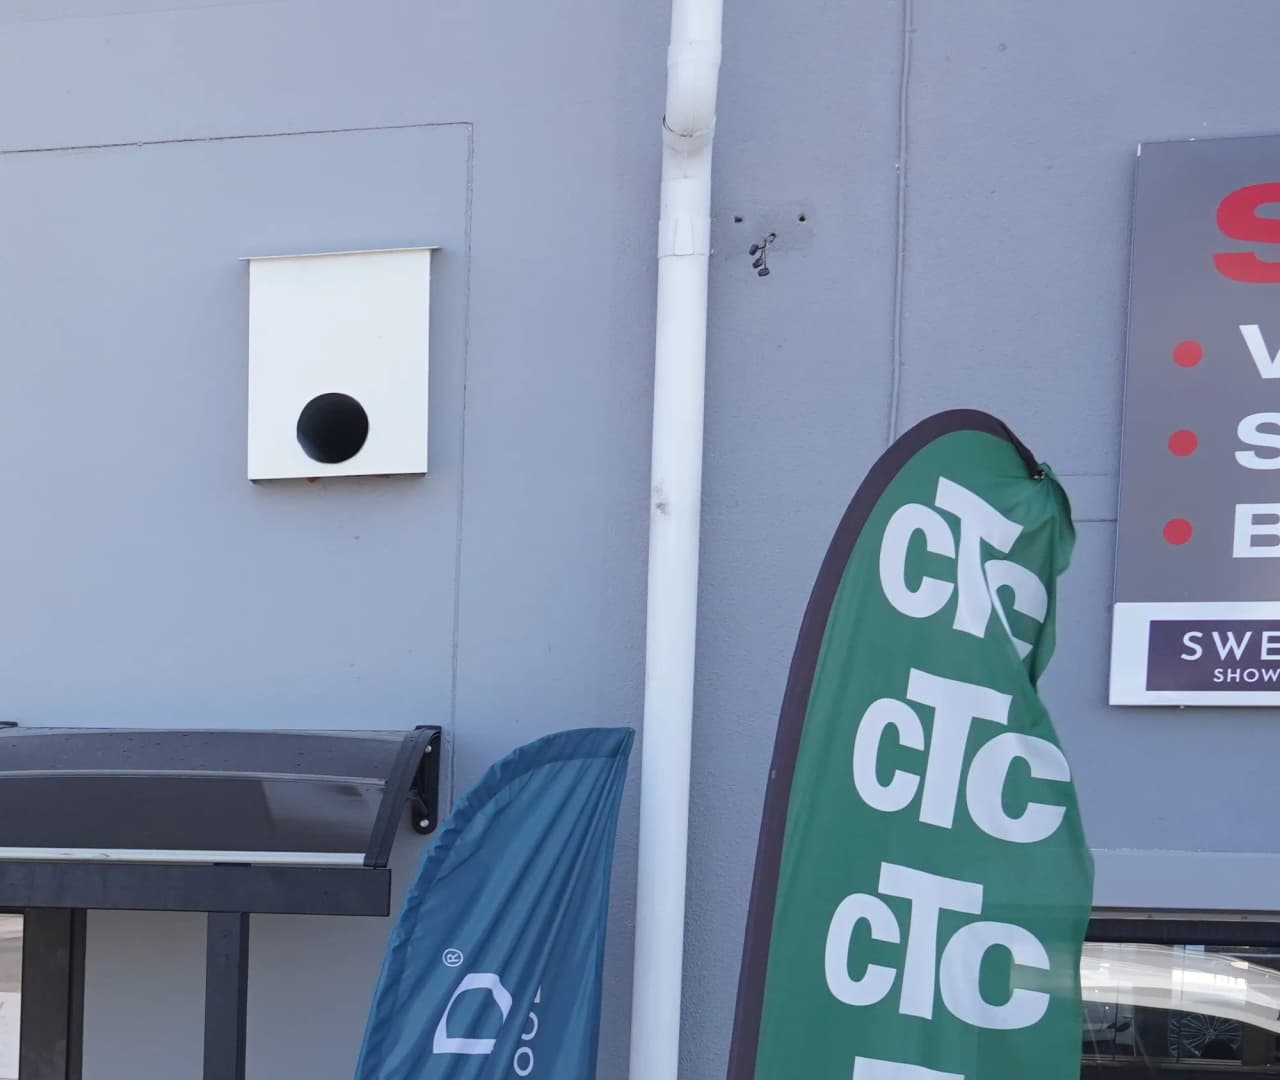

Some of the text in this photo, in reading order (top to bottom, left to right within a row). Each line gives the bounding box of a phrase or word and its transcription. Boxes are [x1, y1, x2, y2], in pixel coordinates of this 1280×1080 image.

[879, 475, 1047, 662] CTC
[852, 667, 1071, 844] CTC
[824, 860, 1050, 1030] CTC
